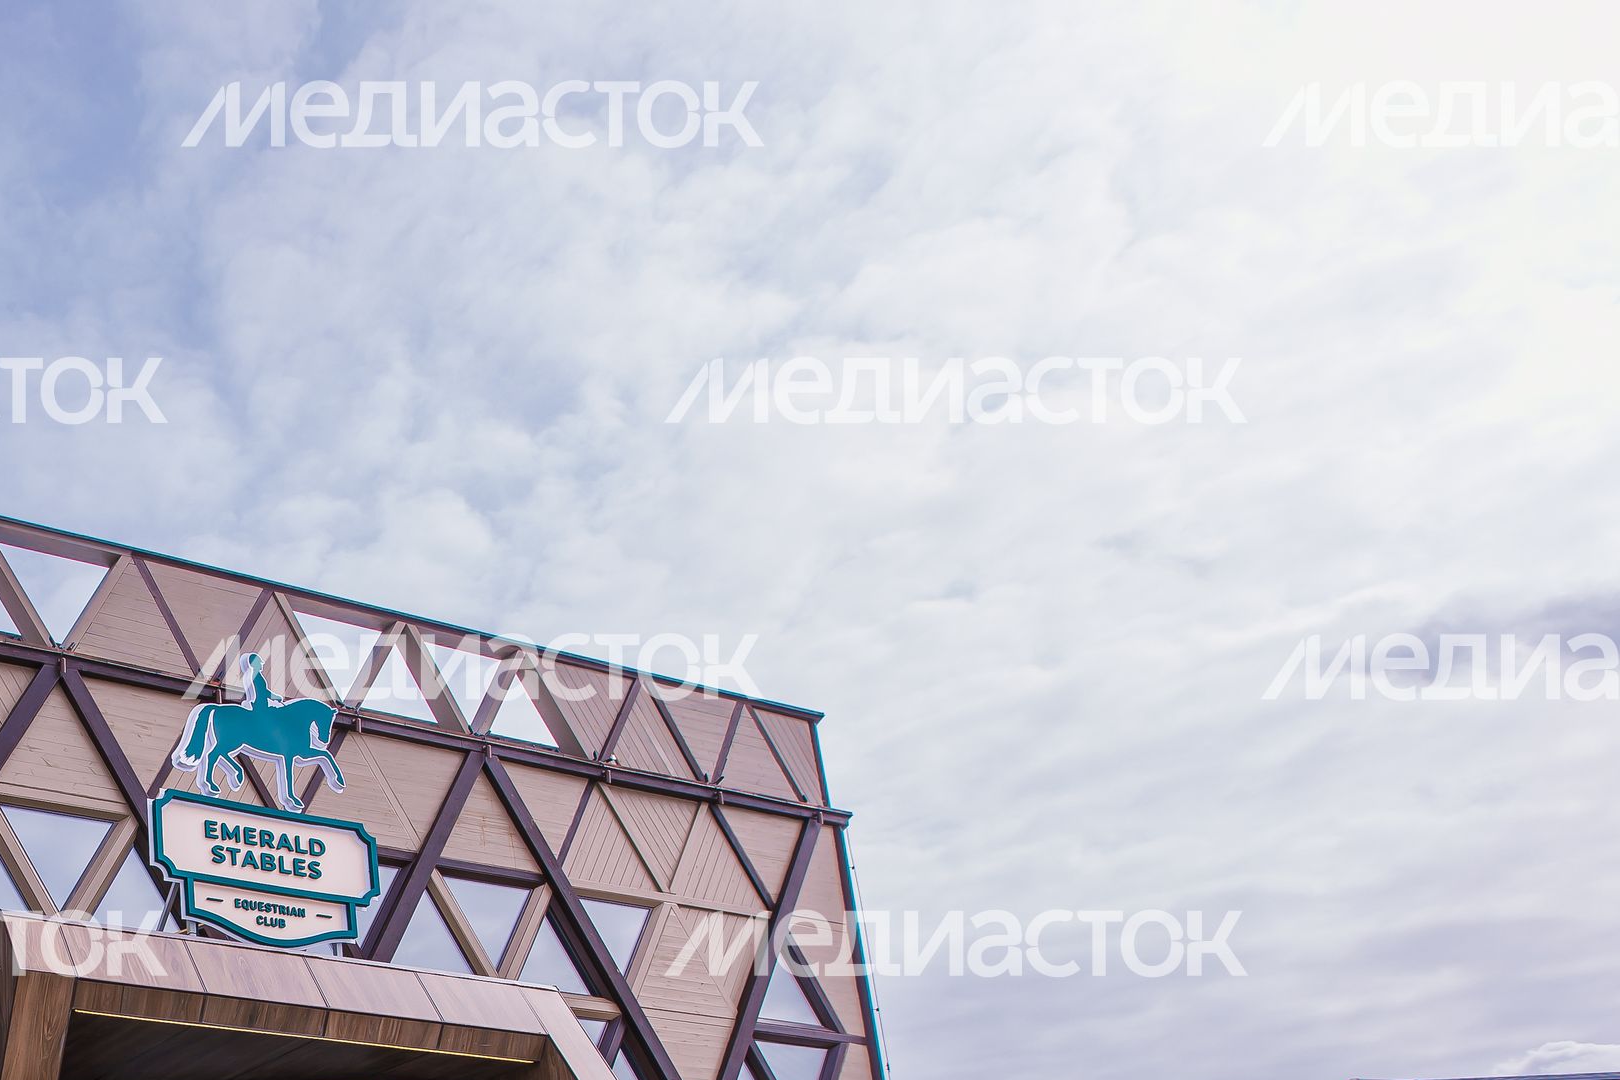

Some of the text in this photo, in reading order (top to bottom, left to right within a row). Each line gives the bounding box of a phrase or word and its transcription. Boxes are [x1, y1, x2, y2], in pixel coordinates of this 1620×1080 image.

[204, 819, 326, 857] EMERALD
[211, 845, 323, 880] STABLES
[234, 898, 306, 919] EQUESTRIAN
[256, 915, 286, 929] CLUB
